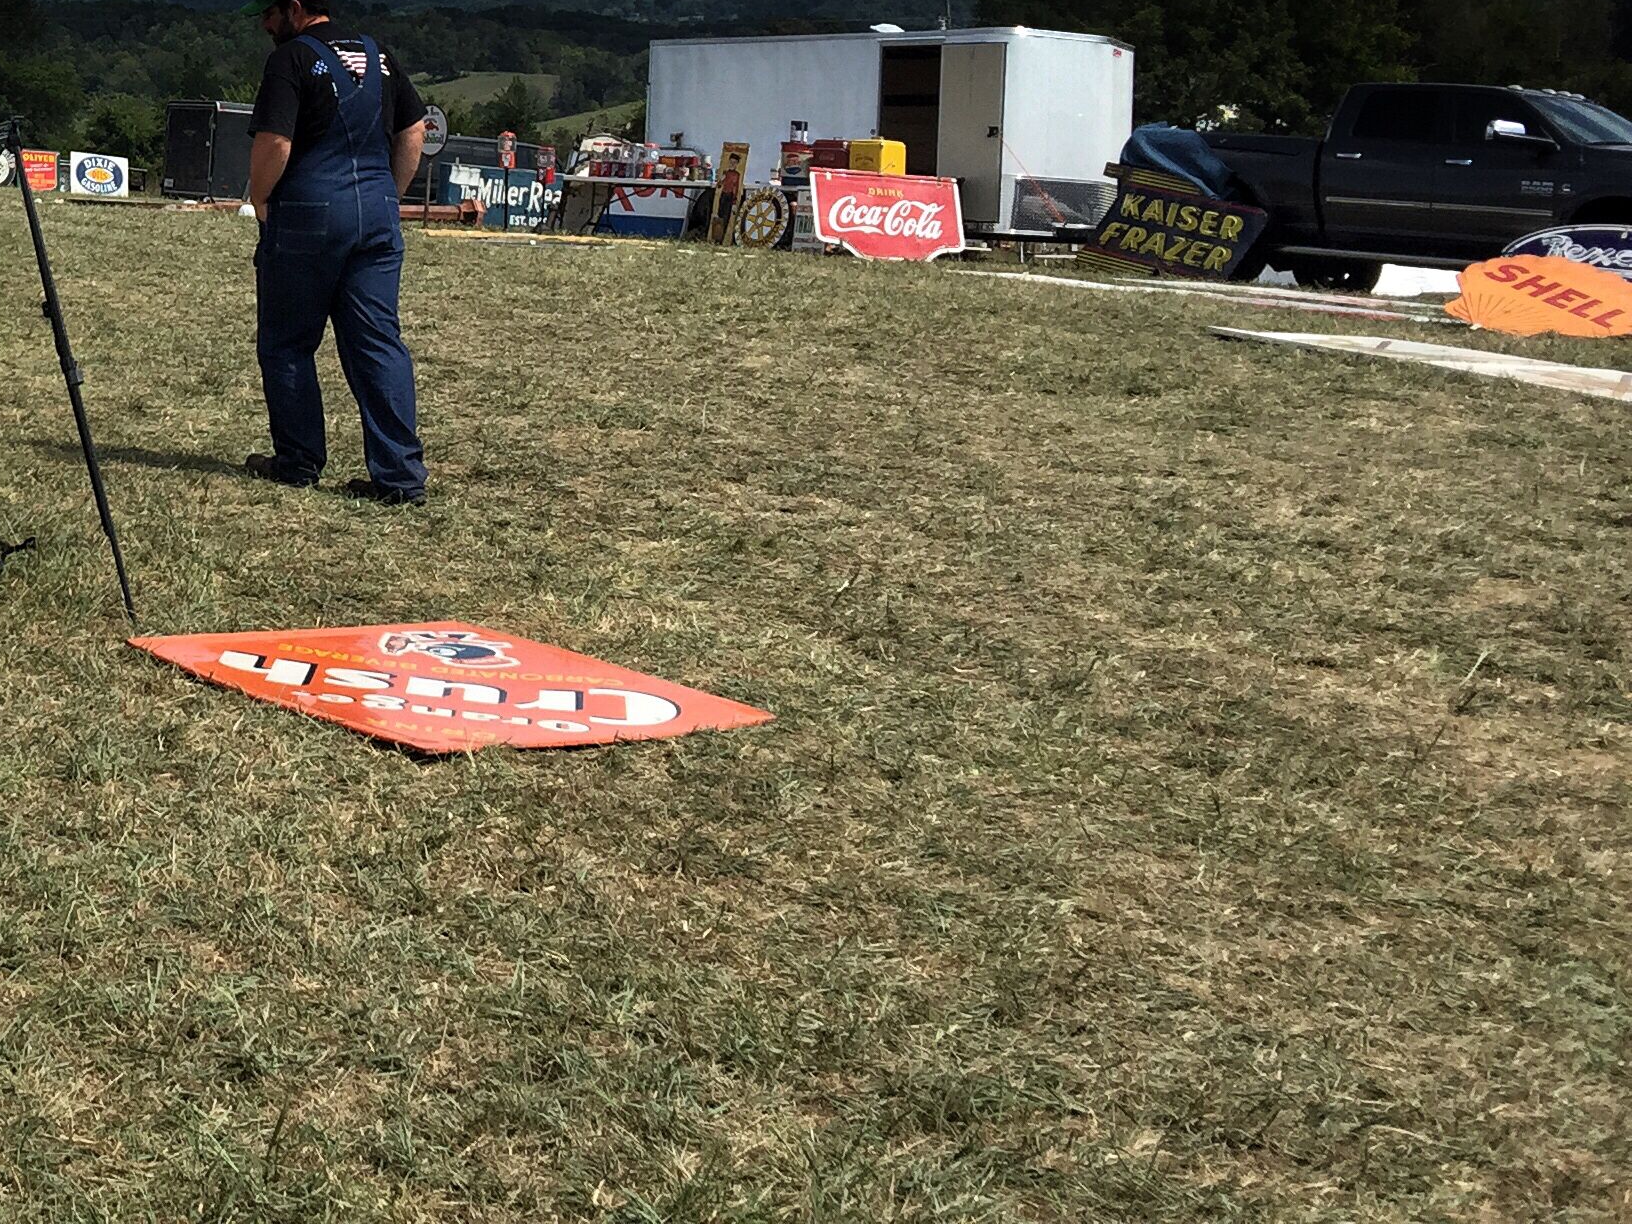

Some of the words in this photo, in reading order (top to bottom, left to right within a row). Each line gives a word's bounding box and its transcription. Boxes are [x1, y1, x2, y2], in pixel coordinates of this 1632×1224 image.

[22, 152, 55, 163] OLIVER
[83, 157, 116, 171] DIXIE
[81, 177, 118, 193] GASOLINE
[460, 184, 476, 200] The
[867, 186, 905, 198] DRINK
[828, 194, 945, 240] Coca-Cola
[1120, 192, 1244, 243] KAISER
[1098, 222, 1234, 272] FRAZER
[1483, 264, 1625, 329] SHELL
[278, 643, 417, 670] BEVERAGE
[218, 649, 681, 727] Crush
[432, 665, 625, 687] CARBONATED
[367, 717, 497, 742] DRINK
